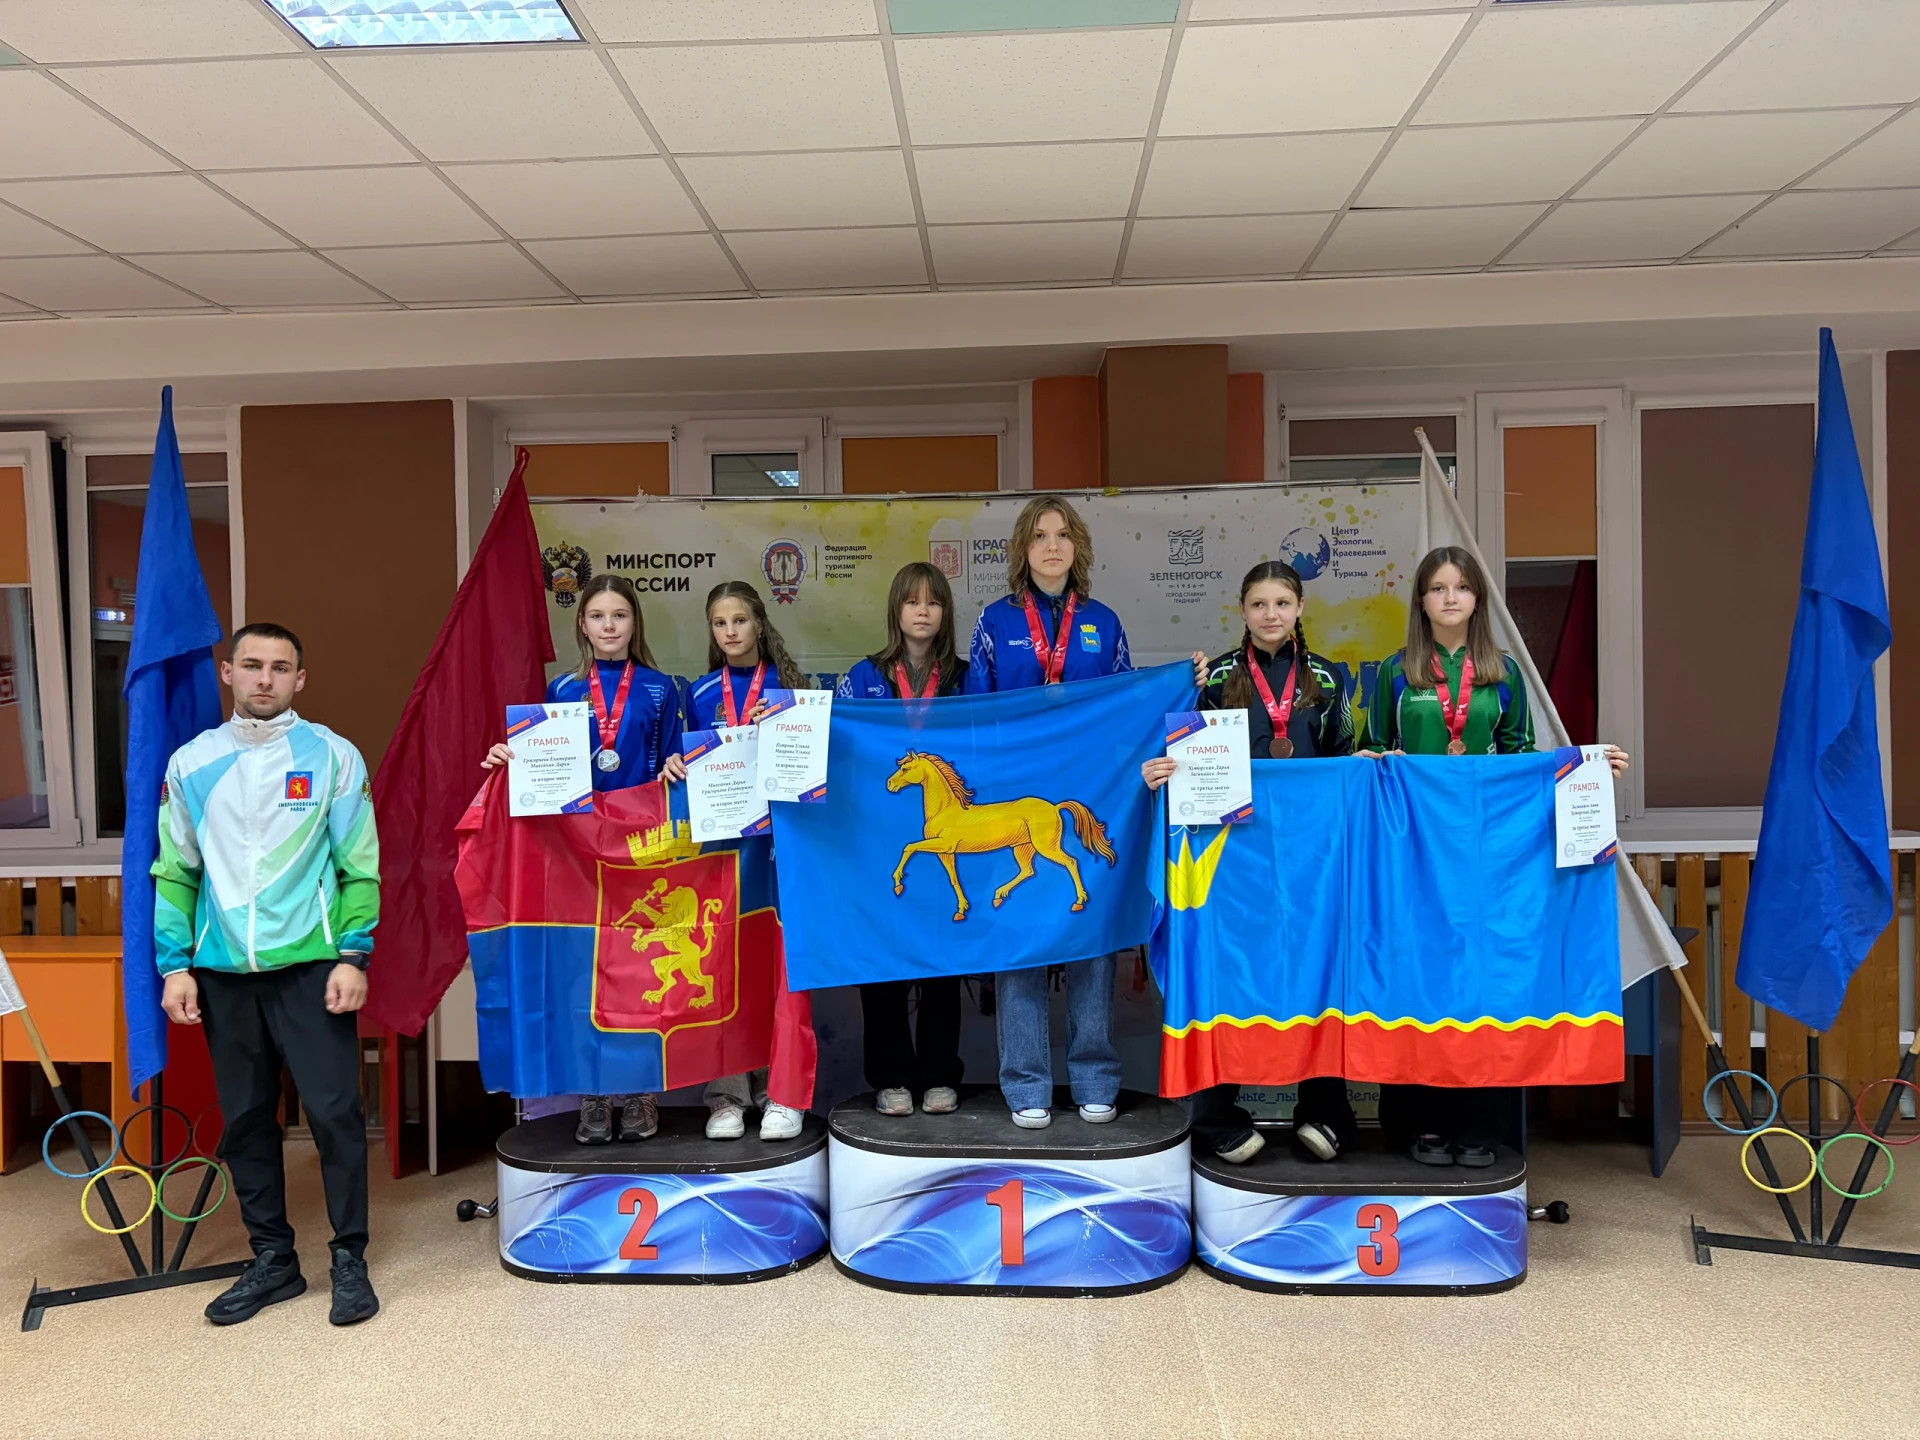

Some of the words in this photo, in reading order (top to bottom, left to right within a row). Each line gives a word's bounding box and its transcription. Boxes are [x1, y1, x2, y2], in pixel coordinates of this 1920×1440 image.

[1331, 526, 1359, 536] Центр
[973, 539, 1008, 550] КРАС
[1332, 537, 1373, 546] Экологии
[824, 545, 867, 553] Федерация
[1332, 548, 1387, 557] Краеведения
[606, 553, 716, 569] МИНСПОРТ
[824, 554, 873, 562] спортивного
[825, 563, 856, 571] туризма
[973, 571, 1009, 581] МИНИС
[1149, 571, 1223, 581] ЗЕЛЕНОГОРСК
[1332, 569, 1368, 579] Туризма
[624, 577, 690, 592] ССИИ
[974, 584, 1011, 594] СПОРТ
[776, 723, 813, 733] ГРАМОТА
[527, 736, 570, 747] ГРАМОТА
[1186, 745, 1230, 755] ГРАМОТА
[704, 761, 746, 773] ГРАМОТА
[1569, 782, 1600, 792] ГРАМОТА
[1236, 1092, 1298, 1104] ные_лы
[1346, 1089, 1379, 1102] Зеле
[618, 1187, 658, 1260] 2
[985, 1179, 1024, 1266] 1
[1357, 1203, 1400, 1277] 3
